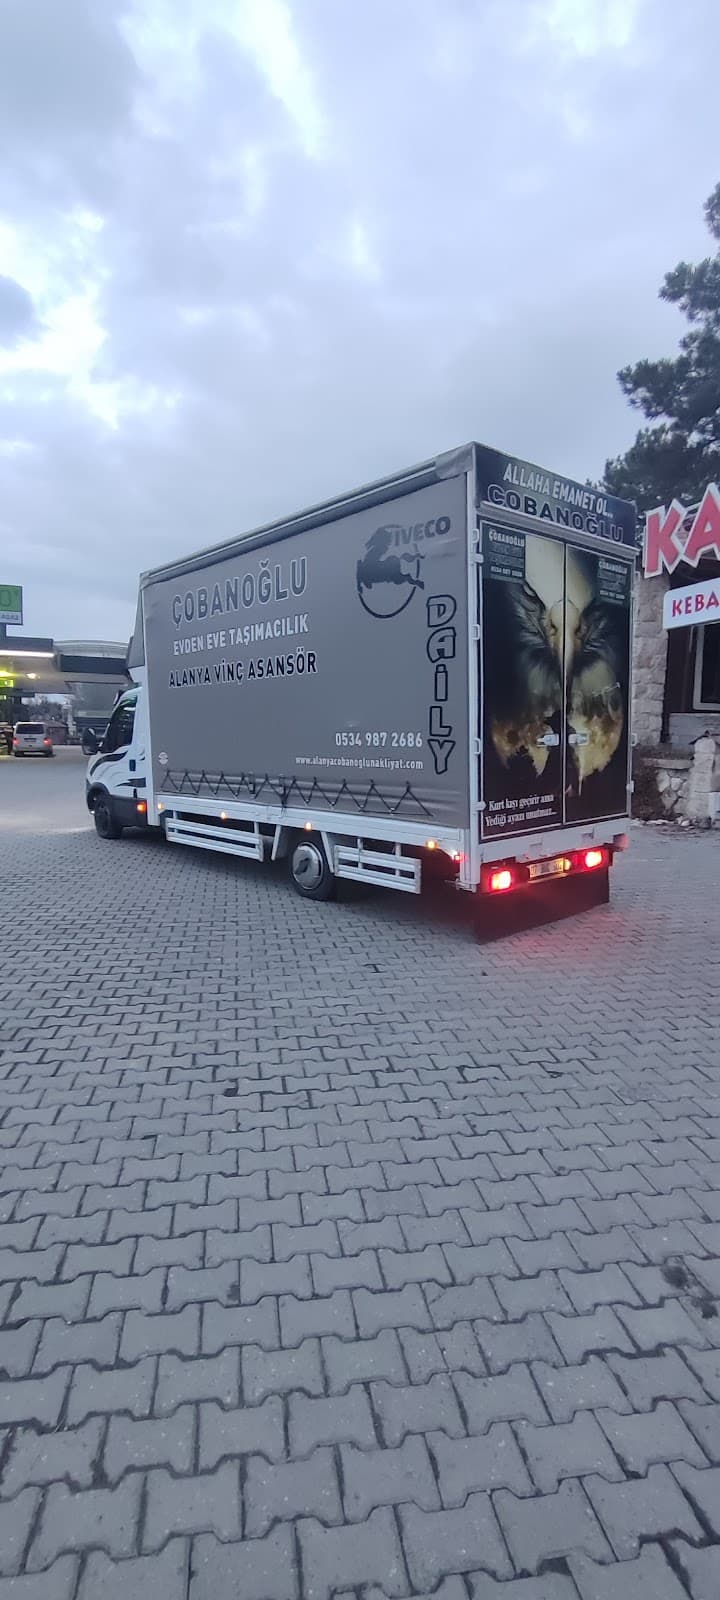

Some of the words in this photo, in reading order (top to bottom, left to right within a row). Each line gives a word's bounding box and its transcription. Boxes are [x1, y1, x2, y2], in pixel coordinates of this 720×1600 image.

[503, 463, 550, 495] ALLAHA
[551, 480, 596, 511] EMANET
[393, 516, 451, 546] IVECO
[172, 556, 307, 630] ÇOBANOĞLU
[173, 637, 204, 656] EVDEN
[206, 630, 227, 650] EVE
[229, 613, 309, 646] TAŞIMACILIK
[169, 666, 212, 688] ALANYA
[213, 659, 244, 685] VİNÇ
[248, 646, 318, 680] ASANSÖR
[335, 732, 362, 746] 0534
[366, 732, 387, 747] 987
[391, 732, 423, 748] 2686
[295, 756, 424, 770] www.alanyacobanoglunakliyat.com
[488, 800, 505, 811] Kurt
